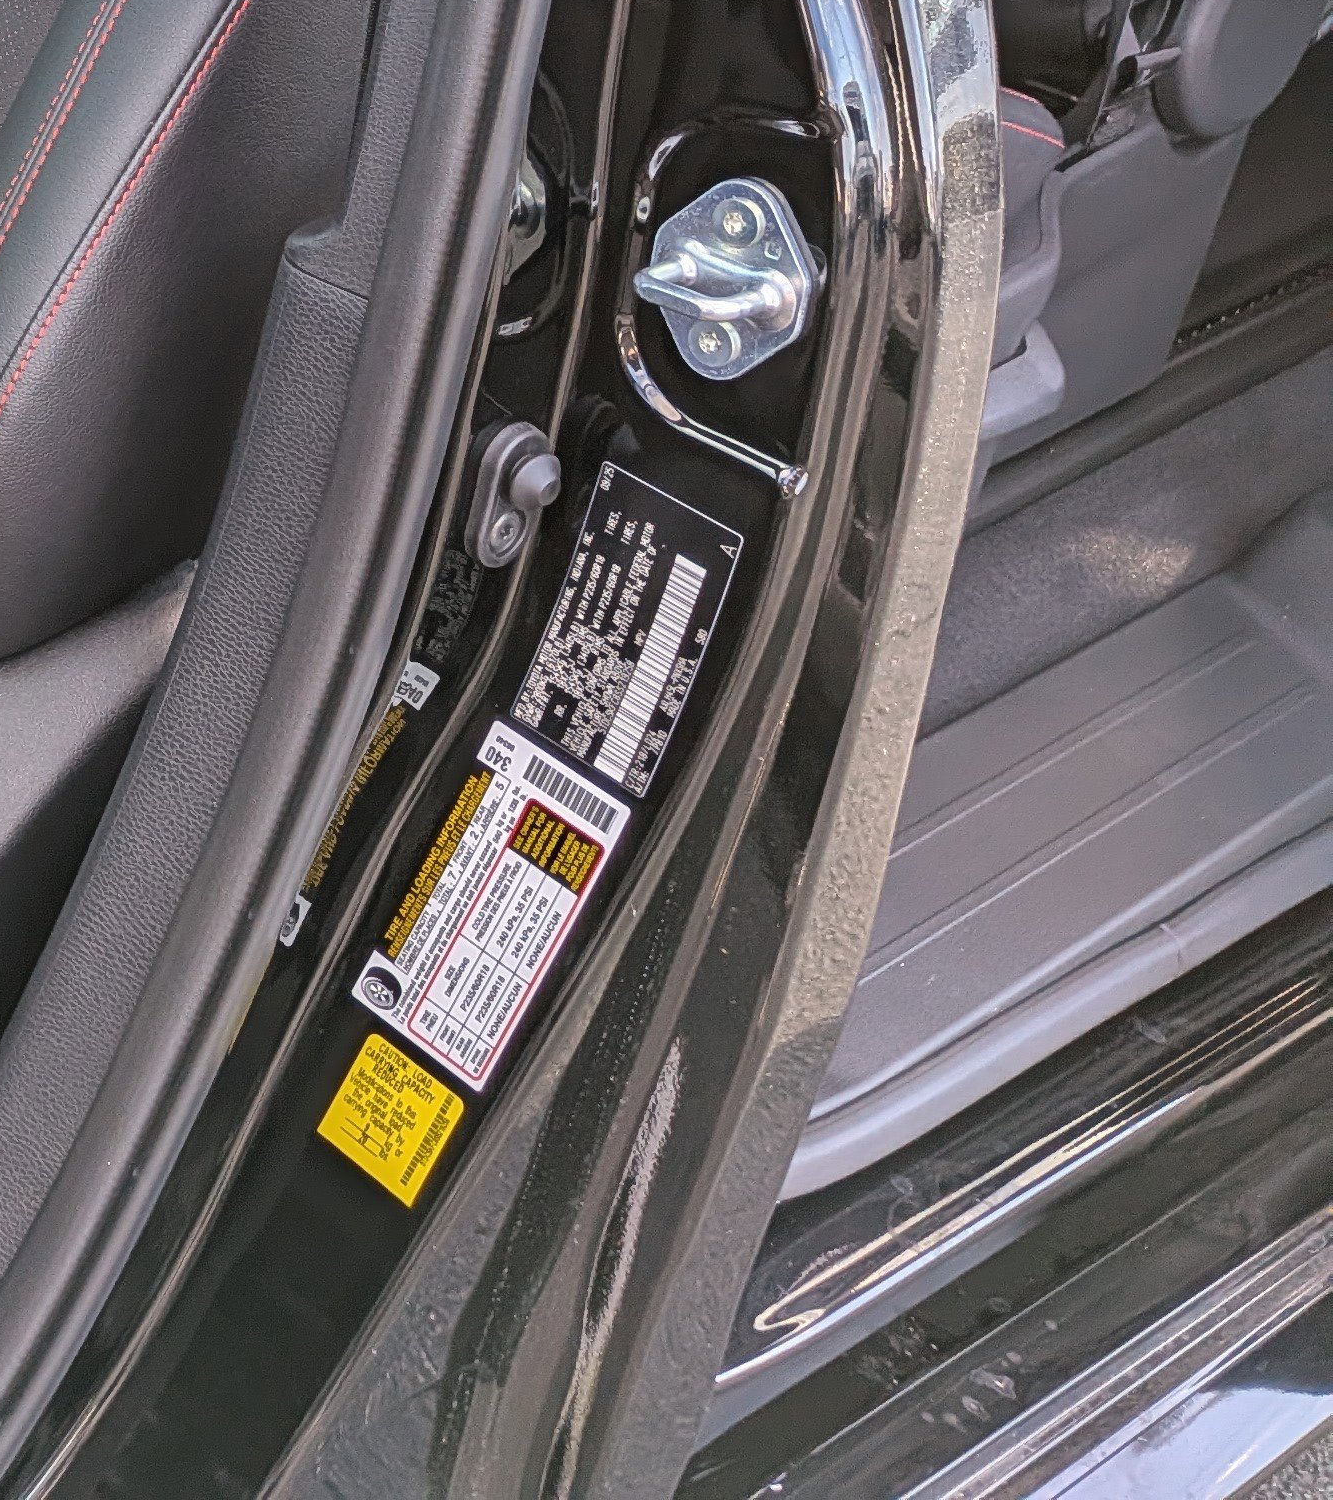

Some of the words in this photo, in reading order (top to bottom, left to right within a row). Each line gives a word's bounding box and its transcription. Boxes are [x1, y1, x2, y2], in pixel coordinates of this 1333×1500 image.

[646, 543, 656, 555] OF
[719, 544, 737, 558] A
[575, 599, 588, 619] WITH
[583, 554, 604, 599] P235/60R18
[604, 511, 621, 534] TIRES,
[639, 556, 653, 576] DATE
[538, 640, 552, 663] MOTOR
[570, 552, 588, 581] INDIANA,
[582, 531, 594, 546] INC.
[632, 577, 646, 592] THE
[629, 593, 639, 605] ON
[553, 704, 567, 717] RR.
[591, 608, 604, 629] WITH
[598, 564, 620, 608] P235/60R18
[620, 521, 637, 544] TIRES,
[617, 606, 634, 635] EFFECT
[560, 727, 575, 746] THIS
[600, 643, 611, 654] TO
[612, 581, 635, 626] APPLICABLE
[628, 550, 646, 580] FEDERAL
[640, 522, 653, 547] MOTOR
[612, 634, 624, 646] IN
[633, 629, 646, 646] MPV
[680, 658, 697, 683] U.S.A.
[675, 683, 686, 694] IN
[666, 696, 681, 717] MADE
[485, 746, 511, 771] 340
[494, 780, 504, 790] 5
[473, 805, 486, 824] REAR
[535, 812, 546, 826] FOR
[469, 830, 479, 840] 2
[531, 821, 554, 858] ADDITIONAL
[538, 823, 564, 866] INFORMATION
[384, 916, 402, 940] TIRE
[399, 893, 415, 916] AND
[411, 847, 440, 893] LOADING
[437, 776, 476, 846] INFORMATION
[388, 894, 426, 956] RENSEIGNEMENTS
[421, 878, 434, 895] SUR
[430, 863, 443, 879] LES
[437, 839, 456, 865] PNEUS
[450, 829, 460, 841] ET
[455, 819, 466, 831] LE
[461, 772, 489, 820] CHARGEMENT
[452, 840, 467, 863] FRONT
[447, 870, 456, 880] 7
[432, 882, 446, 900] TOTAL
[471, 911, 485, 930] COLD
[481, 896, 493, 911] TIRE
[489, 863, 511, 897] PRESSURE
[410, 910, 429, 940] CAPACITY
[445, 957, 469, 996] DIMENSIONS
[475, 914, 493, 941] PRESSION
[489, 902, 500, 914] DES
[496, 883, 510, 902] PNEUS
[509, 861, 521, 879] FROID
[396, 940, 413, 965] SEATING
[403, 945, 420, 971] NOMBRE
[416, 936, 425, 946] DE
[421, 914, 437, 937] PLACES
[460, 964, 489, 1011] P235/60R18
[496, 931, 508, 947] 240
[514, 901, 525, 913] 35
[520, 885, 533, 902] PSI
[475, 975, 504, 1022] P235/60R18
[511, 941, 523, 958] 240
[529, 911, 540, 924] 35
[535, 896, 548, 912] PSI
[487, 982, 521, 1038] NONE/AUCUN
[526, 911, 560, 968] NONE/AUCUN
[365, 1046, 398, 1076] CARRYING
[400, 1074, 434, 1103] CAPACITY
[372, 1063, 404, 1092] REDUCED
[412, 1069, 432, 1088] LOAD
[351, 1087, 362, 1100] the
[365, 1099, 387, 1119] original
[372, 1092, 388, 1108] have
[390, 1107, 415, 1130] reduced
[395, 1097, 403, 1108] to
[404, 1105, 416, 1119] this
[343, 1094, 367, 1118] carrying
[369, 1114, 393, 1138] capacity
[395, 1132, 405, 1147] by
[381, 1139, 393, 1152] kg
[394, 1148, 403, 1157] or
